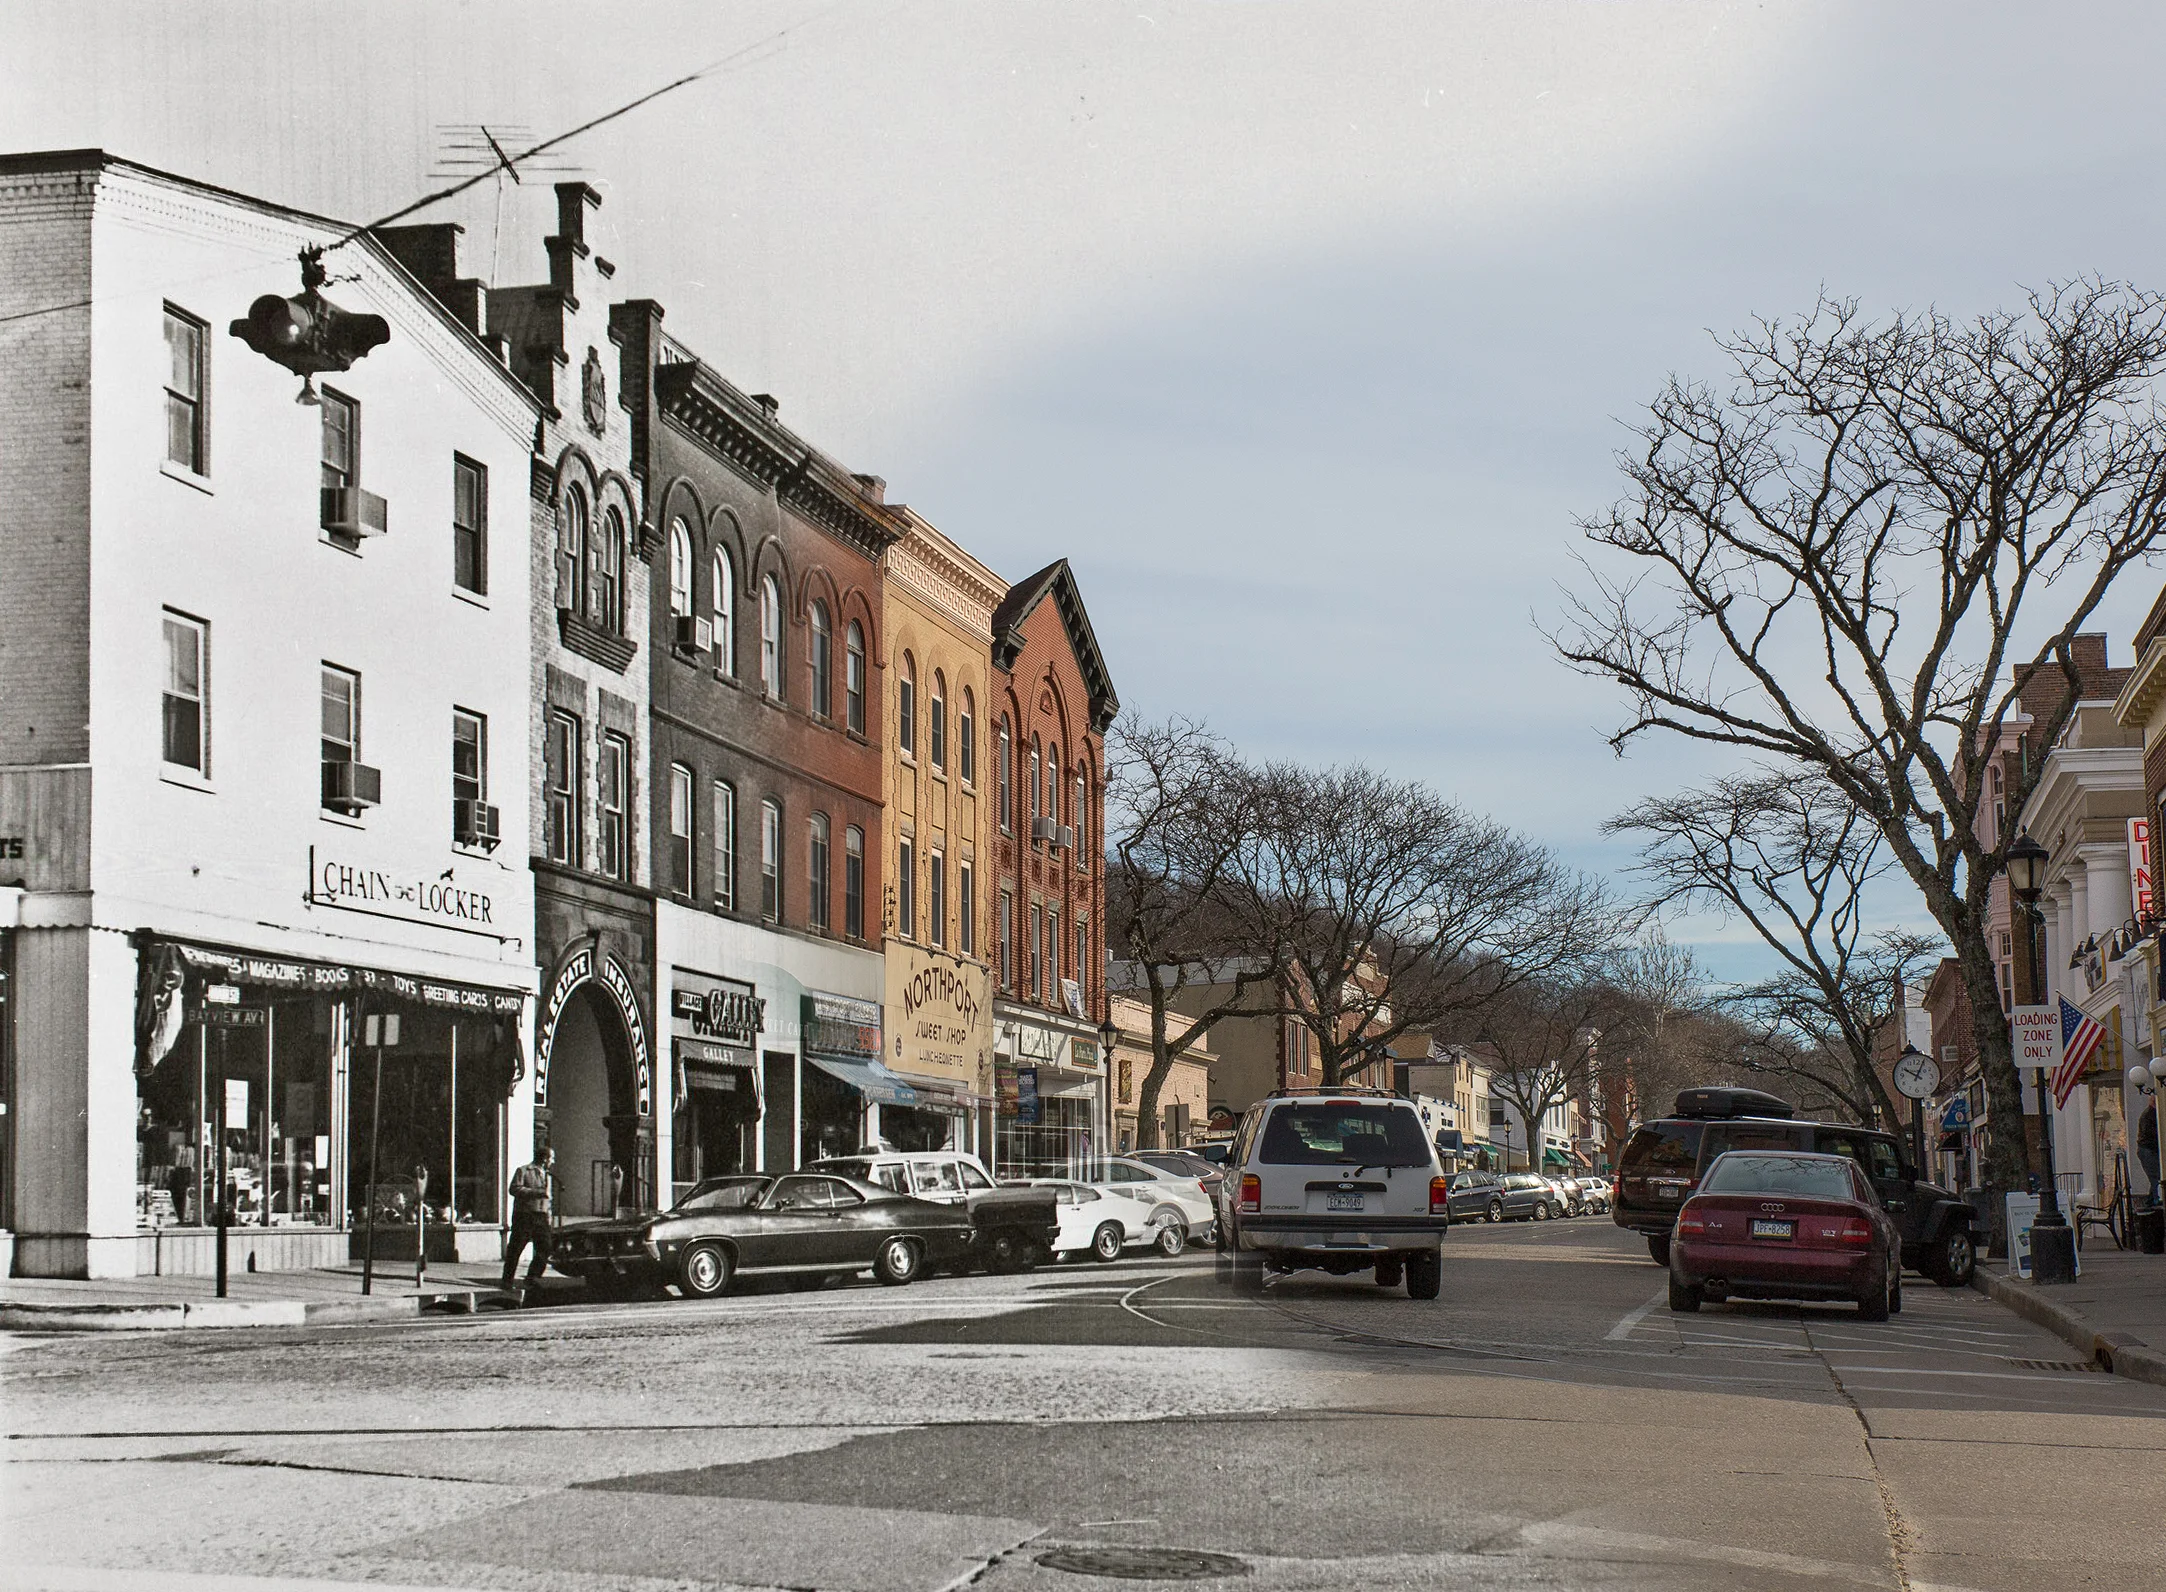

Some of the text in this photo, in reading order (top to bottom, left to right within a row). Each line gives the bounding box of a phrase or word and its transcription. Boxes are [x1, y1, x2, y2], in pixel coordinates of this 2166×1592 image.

[324, 862, 492, 923] CHAIN LOCKER
[249, 960, 306, 981] MAGAZINES
[315, 967, 349, 983] BOOKS
[392, 975, 417, 995] TOYS
[422, 984, 460, 1004] GREETING
[461, 990, 488, 1007] CARDS
[494, 996, 523, 1010] CANDY
[708, 989, 767, 1033] GALLEY
[904, 966, 979, 1033] NORTHPORT
[188, 1009, 239, 1023] BAYVIEW
[535, 955, 586, 1095] REAL ESTATE
[2014, 1013, 2058, 1026] LOADING
[604, 961, 648, 1102] INSURANCE
[916, 1020, 967, 1046] SWEET SHOP
[2023, 1030, 2053, 1041] ZONE
[703, 1047, 734, 1062] GALLEY
[919, 1048, 963, 1067] LUNCHEONETTE
[2024, 1046, 2053, 1057] ONLY
